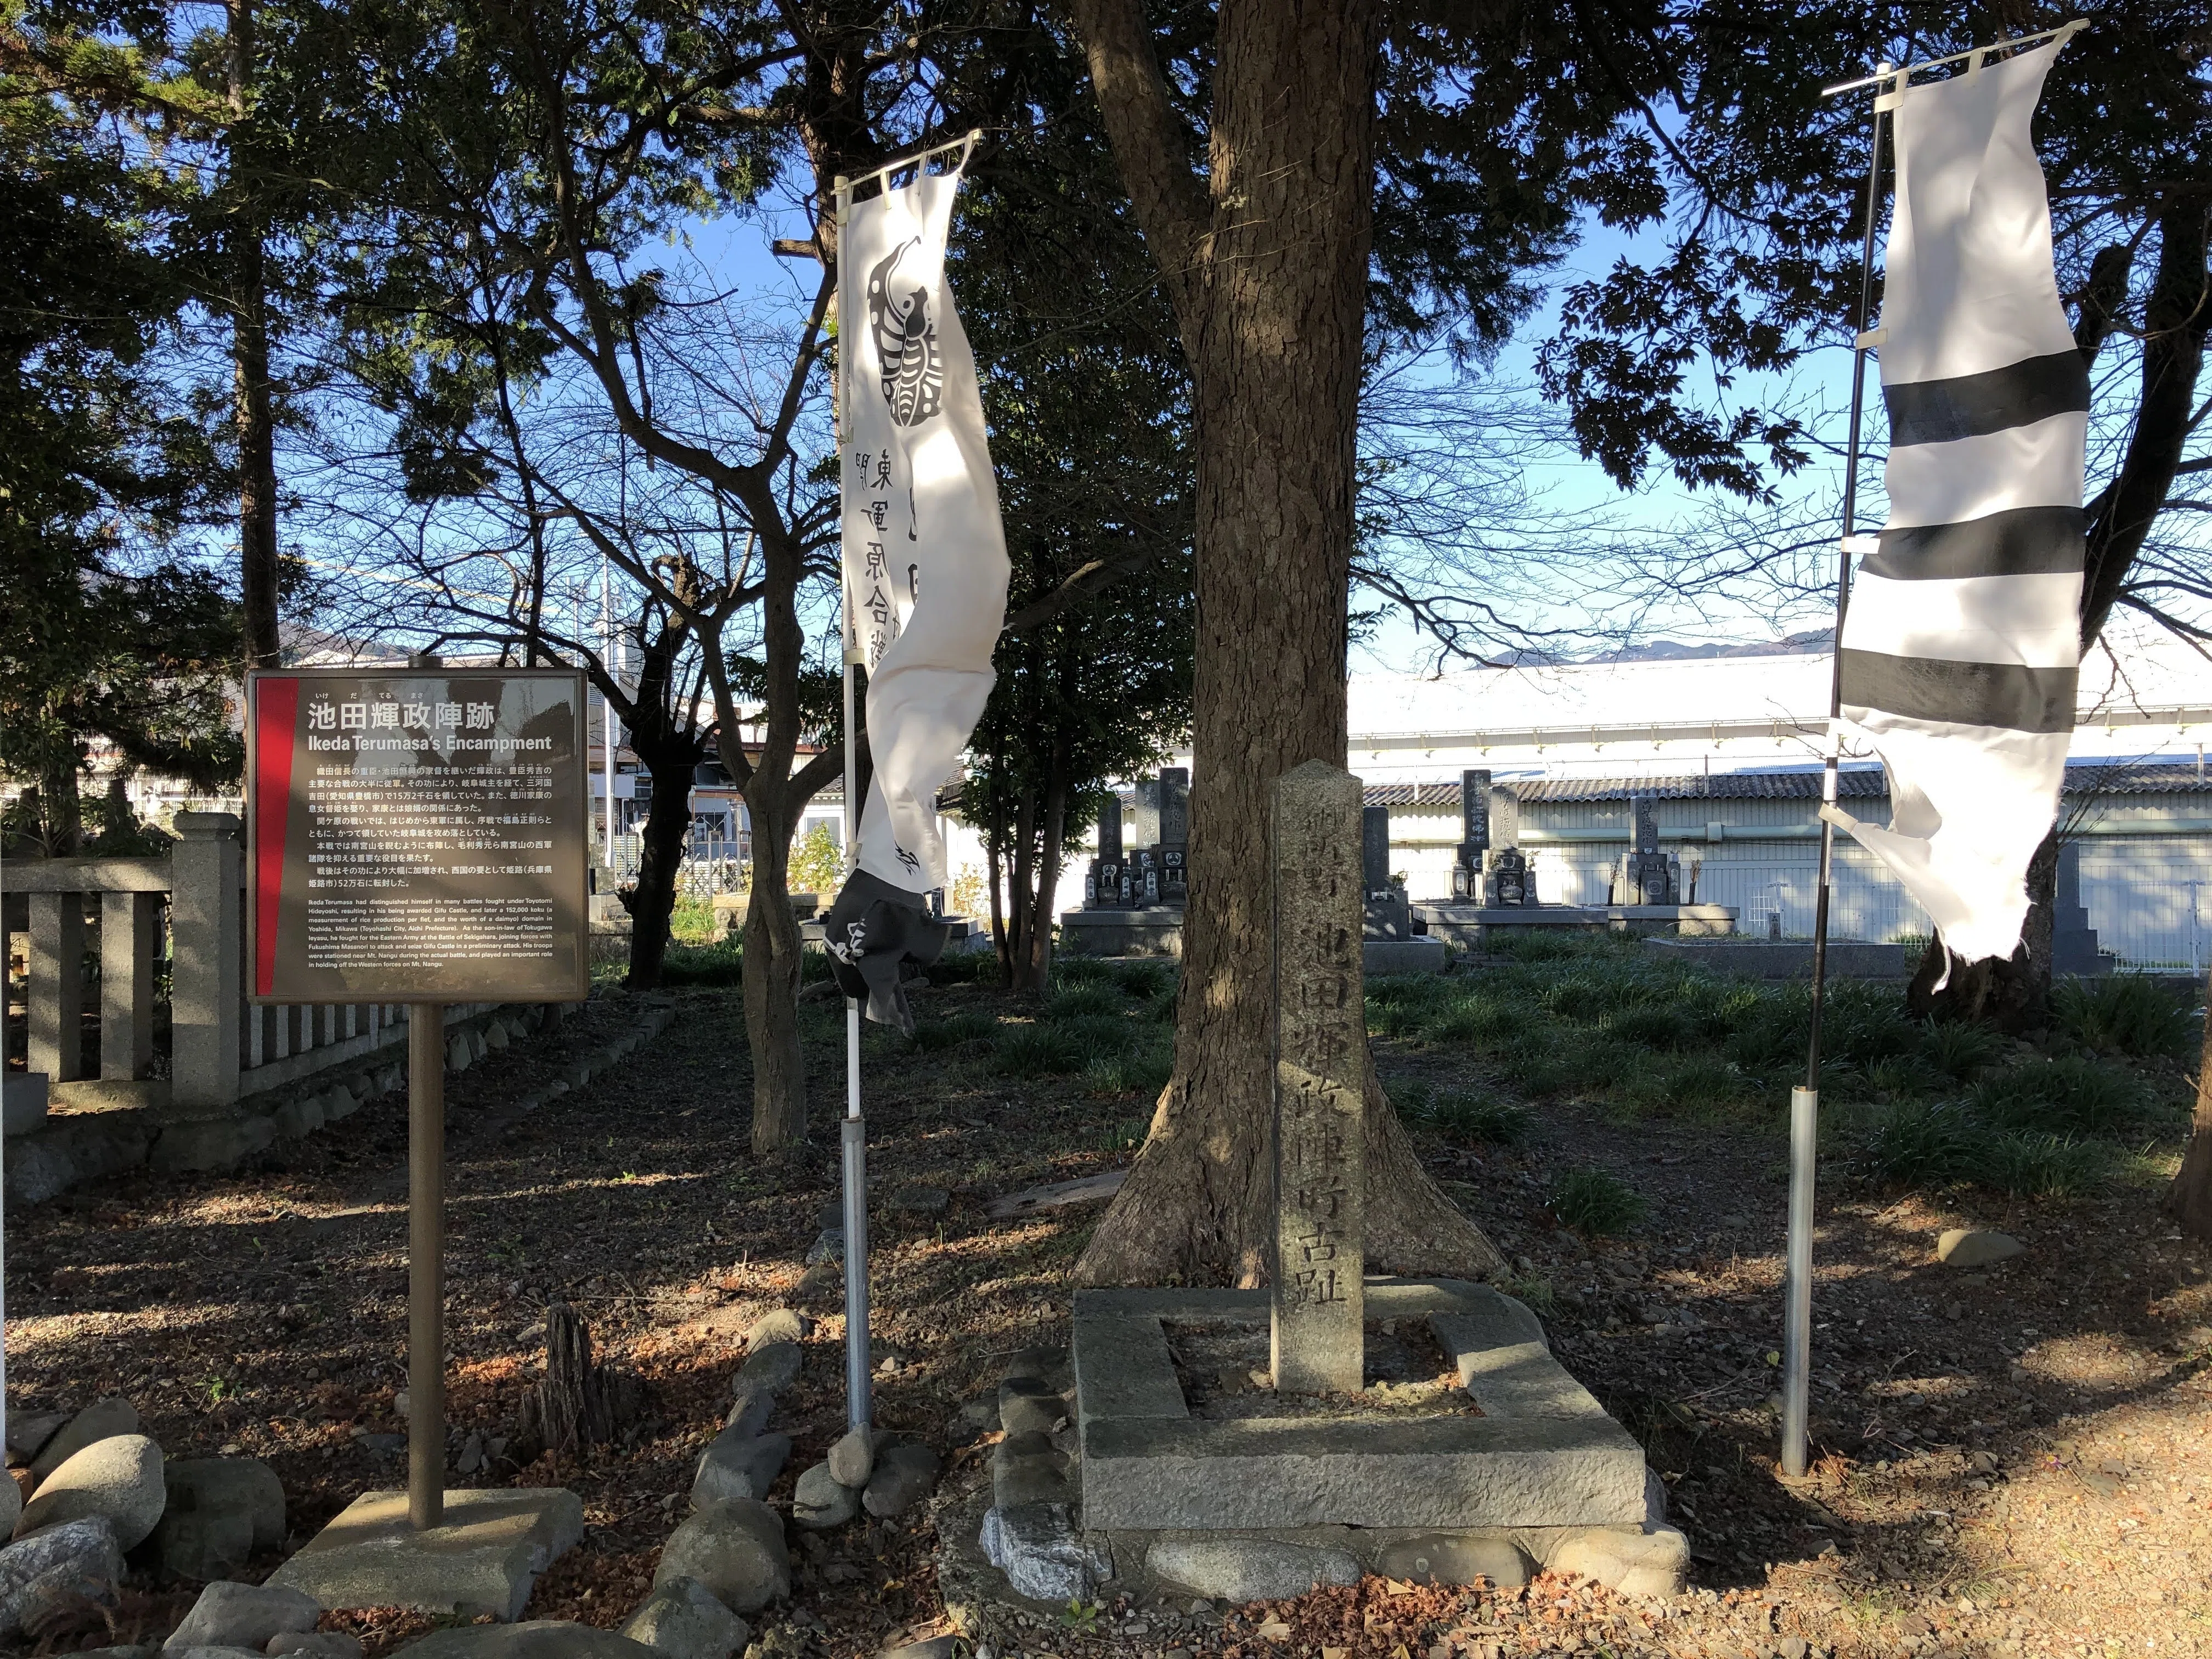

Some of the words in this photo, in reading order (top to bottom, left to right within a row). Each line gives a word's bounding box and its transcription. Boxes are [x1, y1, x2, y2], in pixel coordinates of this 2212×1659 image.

[308, 702, 495, 730] 池田輝政陣跡
[308, 736, 350, 751] Ikeda
[447, 735, 552, 753] Encampment
